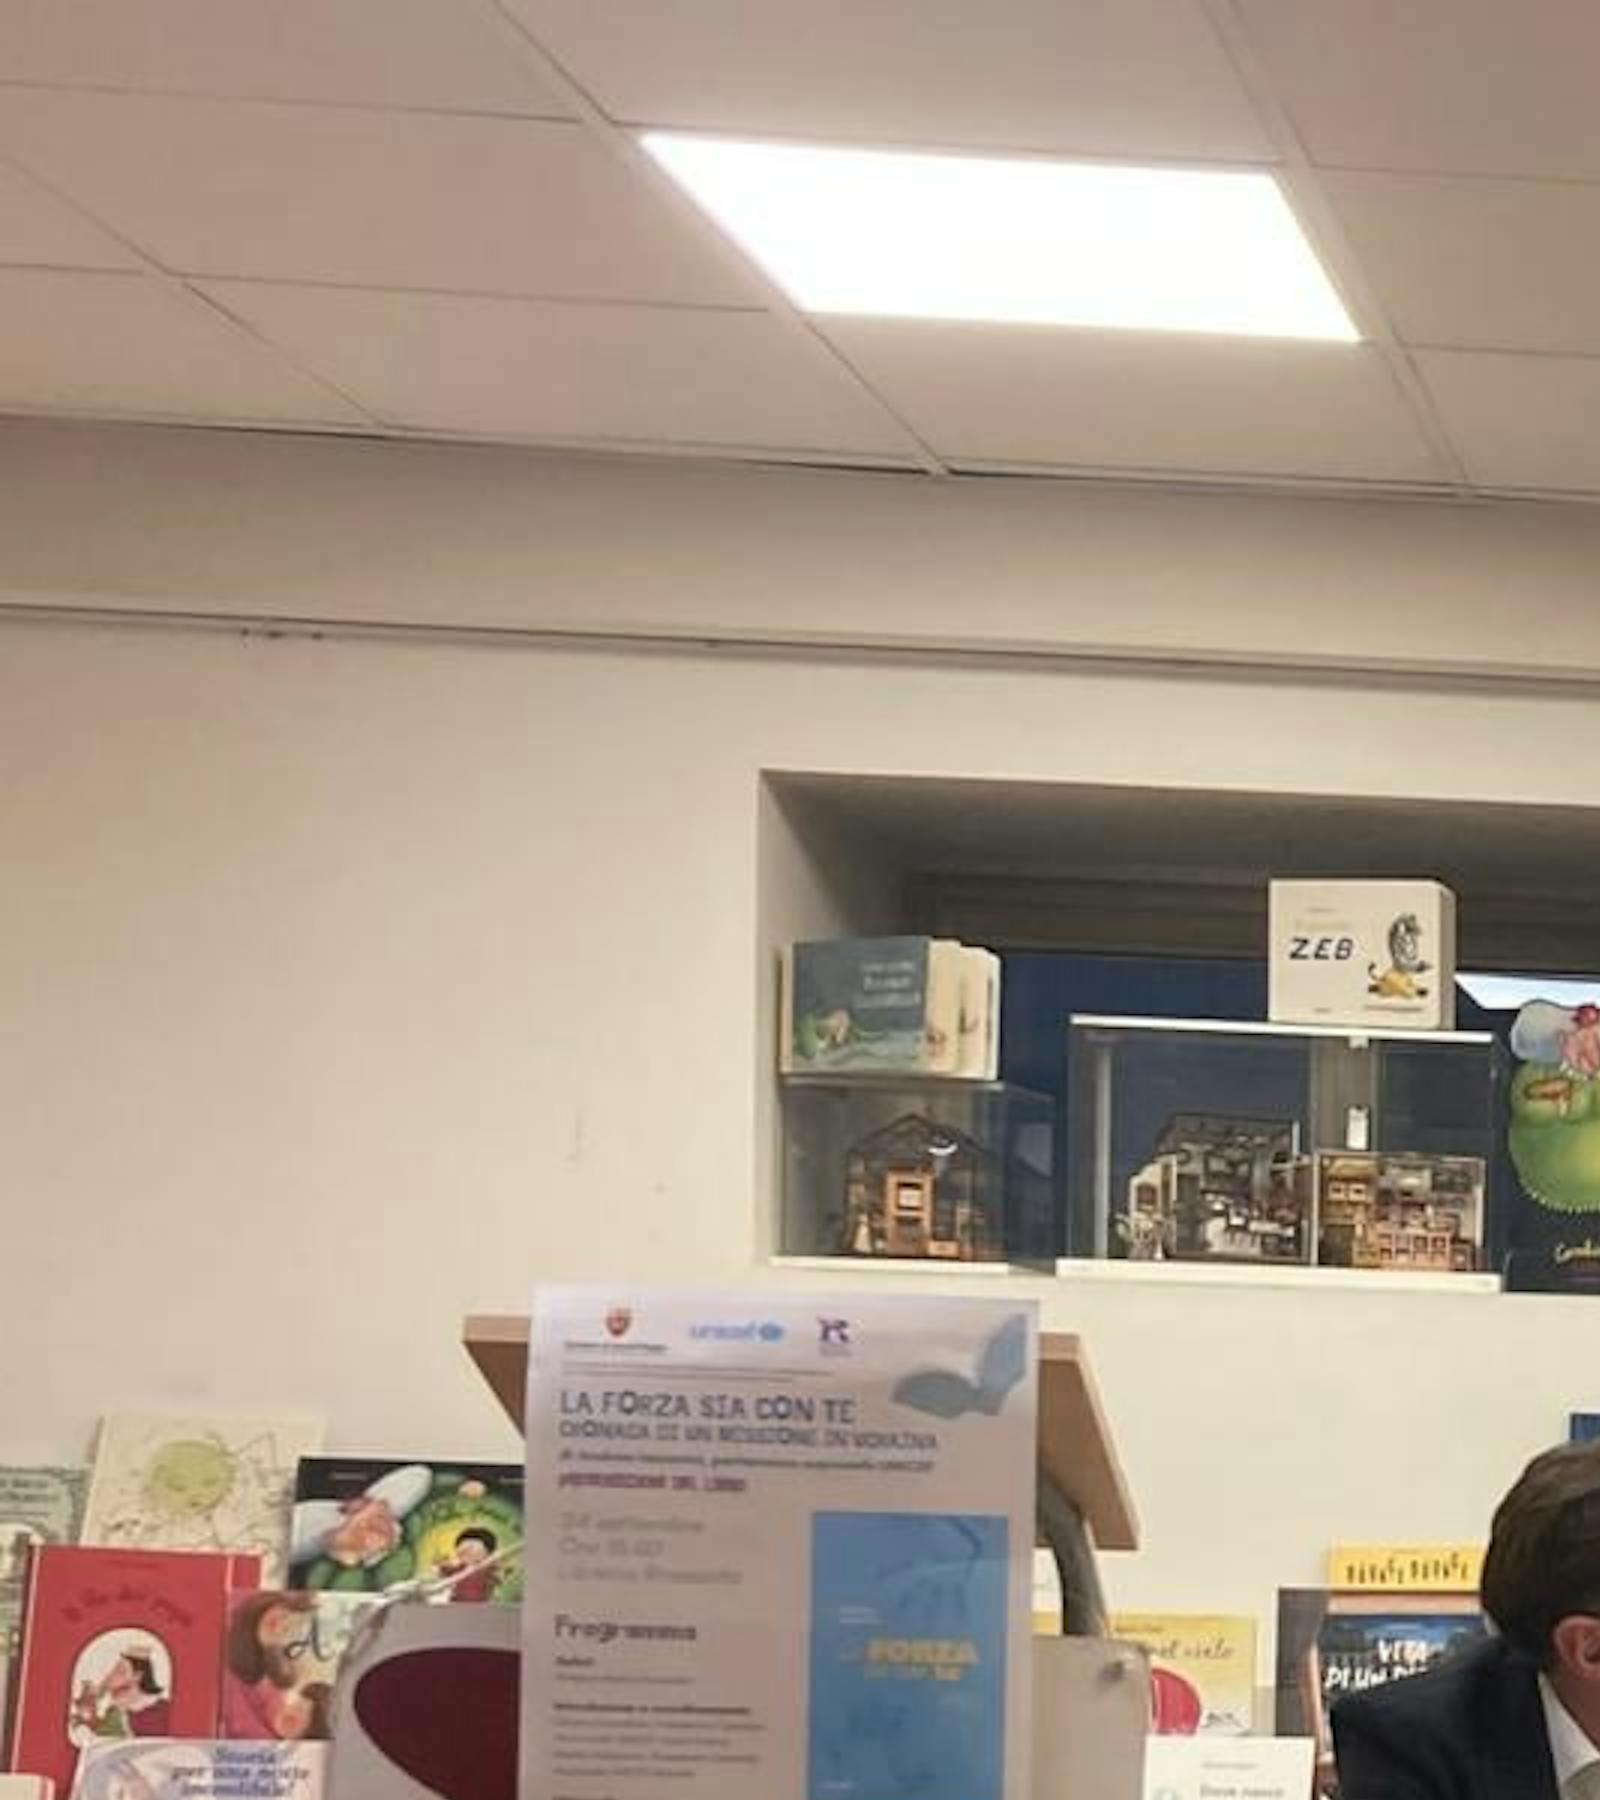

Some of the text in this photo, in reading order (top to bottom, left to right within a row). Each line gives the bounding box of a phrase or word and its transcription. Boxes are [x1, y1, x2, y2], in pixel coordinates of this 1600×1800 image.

[1288, 937, 1354, 961] ZEB
[560, 1391, 856, 1424] LA FORZA SIA CON TE
[825, 1429, 847, 1447] IN
[555, 1614, 697, 1643] Programma
